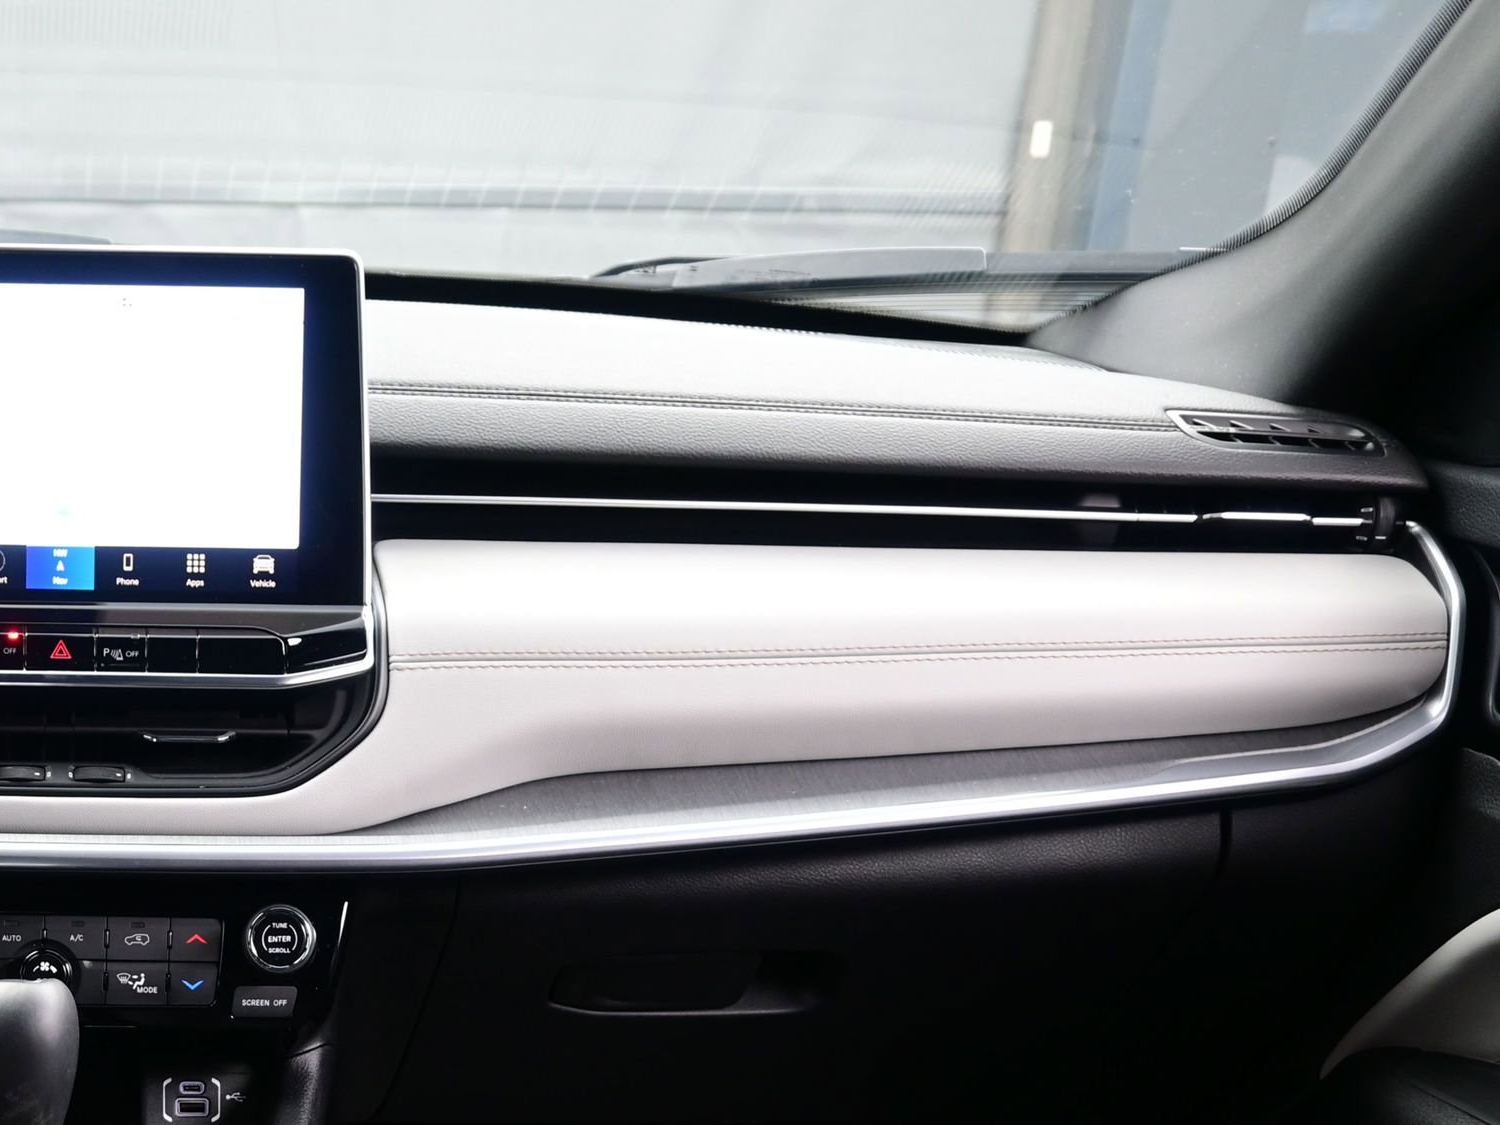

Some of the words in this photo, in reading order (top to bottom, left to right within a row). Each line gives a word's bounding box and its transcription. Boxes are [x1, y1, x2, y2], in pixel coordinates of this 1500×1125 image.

[116, 577, 140, 587] Phone
[186, 578, 205, 588] Apps
[250, 579, 276, 588] Vehicle
[3, 647, 17, 655] OFF
[125, 650, 140, 658] OFF
[2, 934, 22, 943] AUTO
[69, 933, 84, 943] A/C
[267, 935, 292, 943] ENTER
[137, 986, 159, 994] MODE
[241, 999, 270, 1007] SCREEN
[273, 999, 288, 1007] OFF
